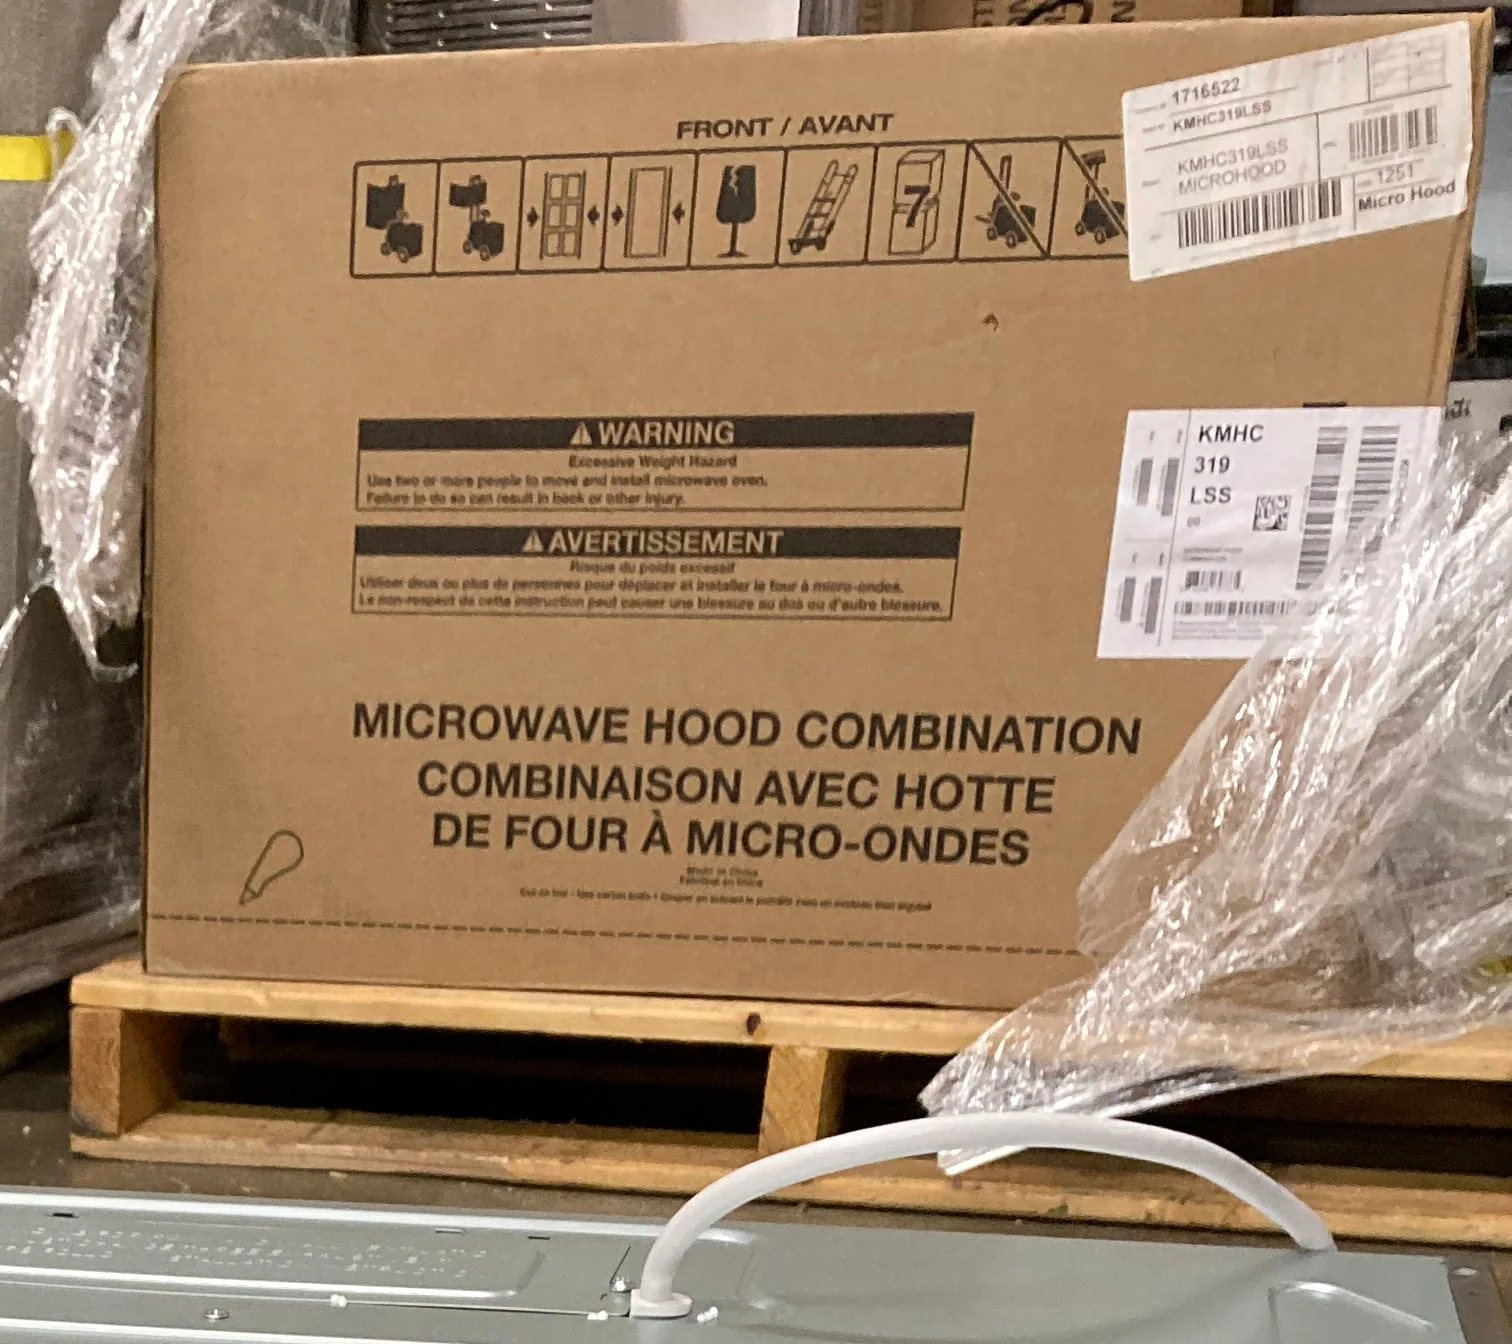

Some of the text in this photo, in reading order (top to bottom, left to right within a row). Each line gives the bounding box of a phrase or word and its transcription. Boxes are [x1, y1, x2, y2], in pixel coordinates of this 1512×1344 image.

[1171, 76, 1241, 105] 1716522
[677, 113, 894, 140] FRONT / AVANT
[1173, 100, 1272, 132] KMHC319LSS
[1177, 138, 1289, 176] KMHC319LSS
[1179, 159, 1287, 195] MICROHOOD
[1377, 163, 1414, 185] 1251
[904, 185, 931, 228] 7
[1358, 179, 1456, 212] Micro Hood
[597, 420, 735, 446] WARNING
[1198, 424, 1264, 443] KMHC
[1194, 455, 1231, 474] 319
[1190, 486, 1232, 505] LSS
[548, 529, 785, 555] AVERTISSEMENT
[352, 701, 1143, 756] MICROWAVE HOOD COMBINATION
[417, 760, 1057, 814] COMBINAISON AVEC HOTTE
[432, 809, 1031, 867] DE FOUR À MICRO-ONDES
